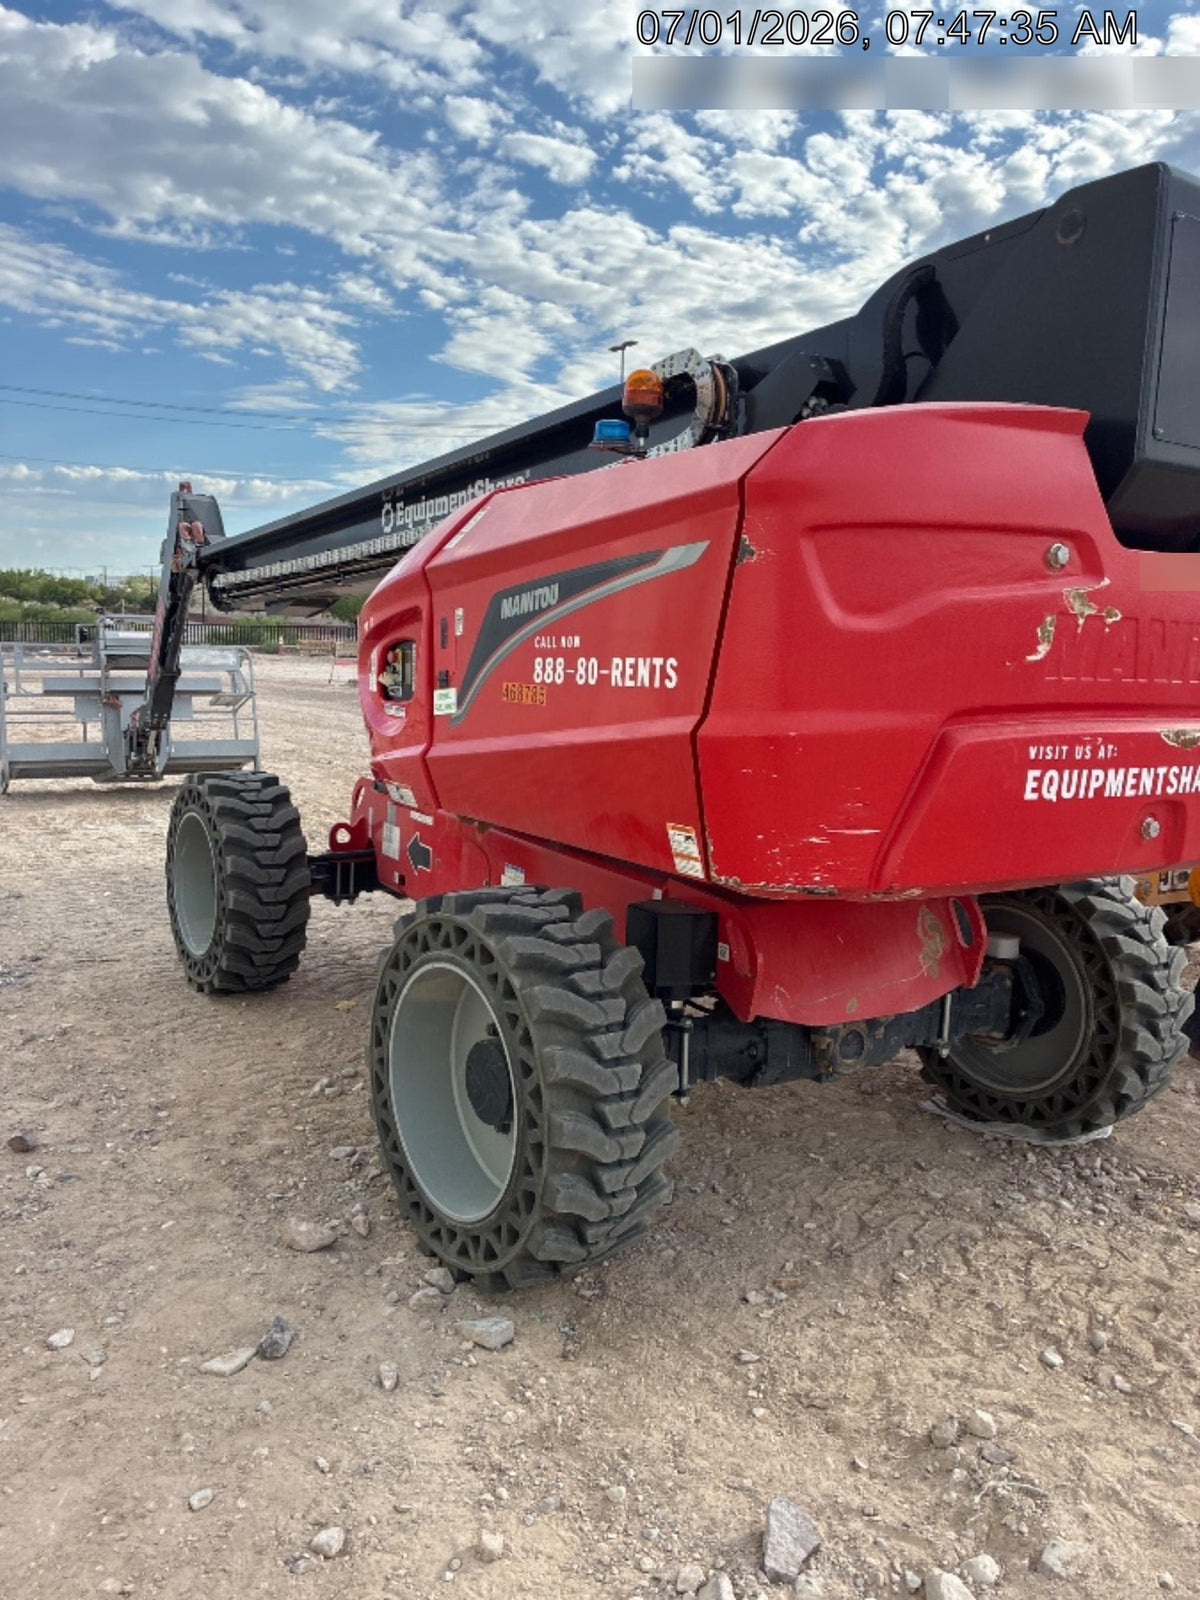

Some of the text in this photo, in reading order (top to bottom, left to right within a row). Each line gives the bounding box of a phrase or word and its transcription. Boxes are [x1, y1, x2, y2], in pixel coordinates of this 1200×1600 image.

[501, 583, 560, 619] MANITOU
[534, 635, 557, 649] CALL
[533, 657, 678, 688] 888-80-RENTS
[1029, 745, 1118, 760] VISIT US AT:
